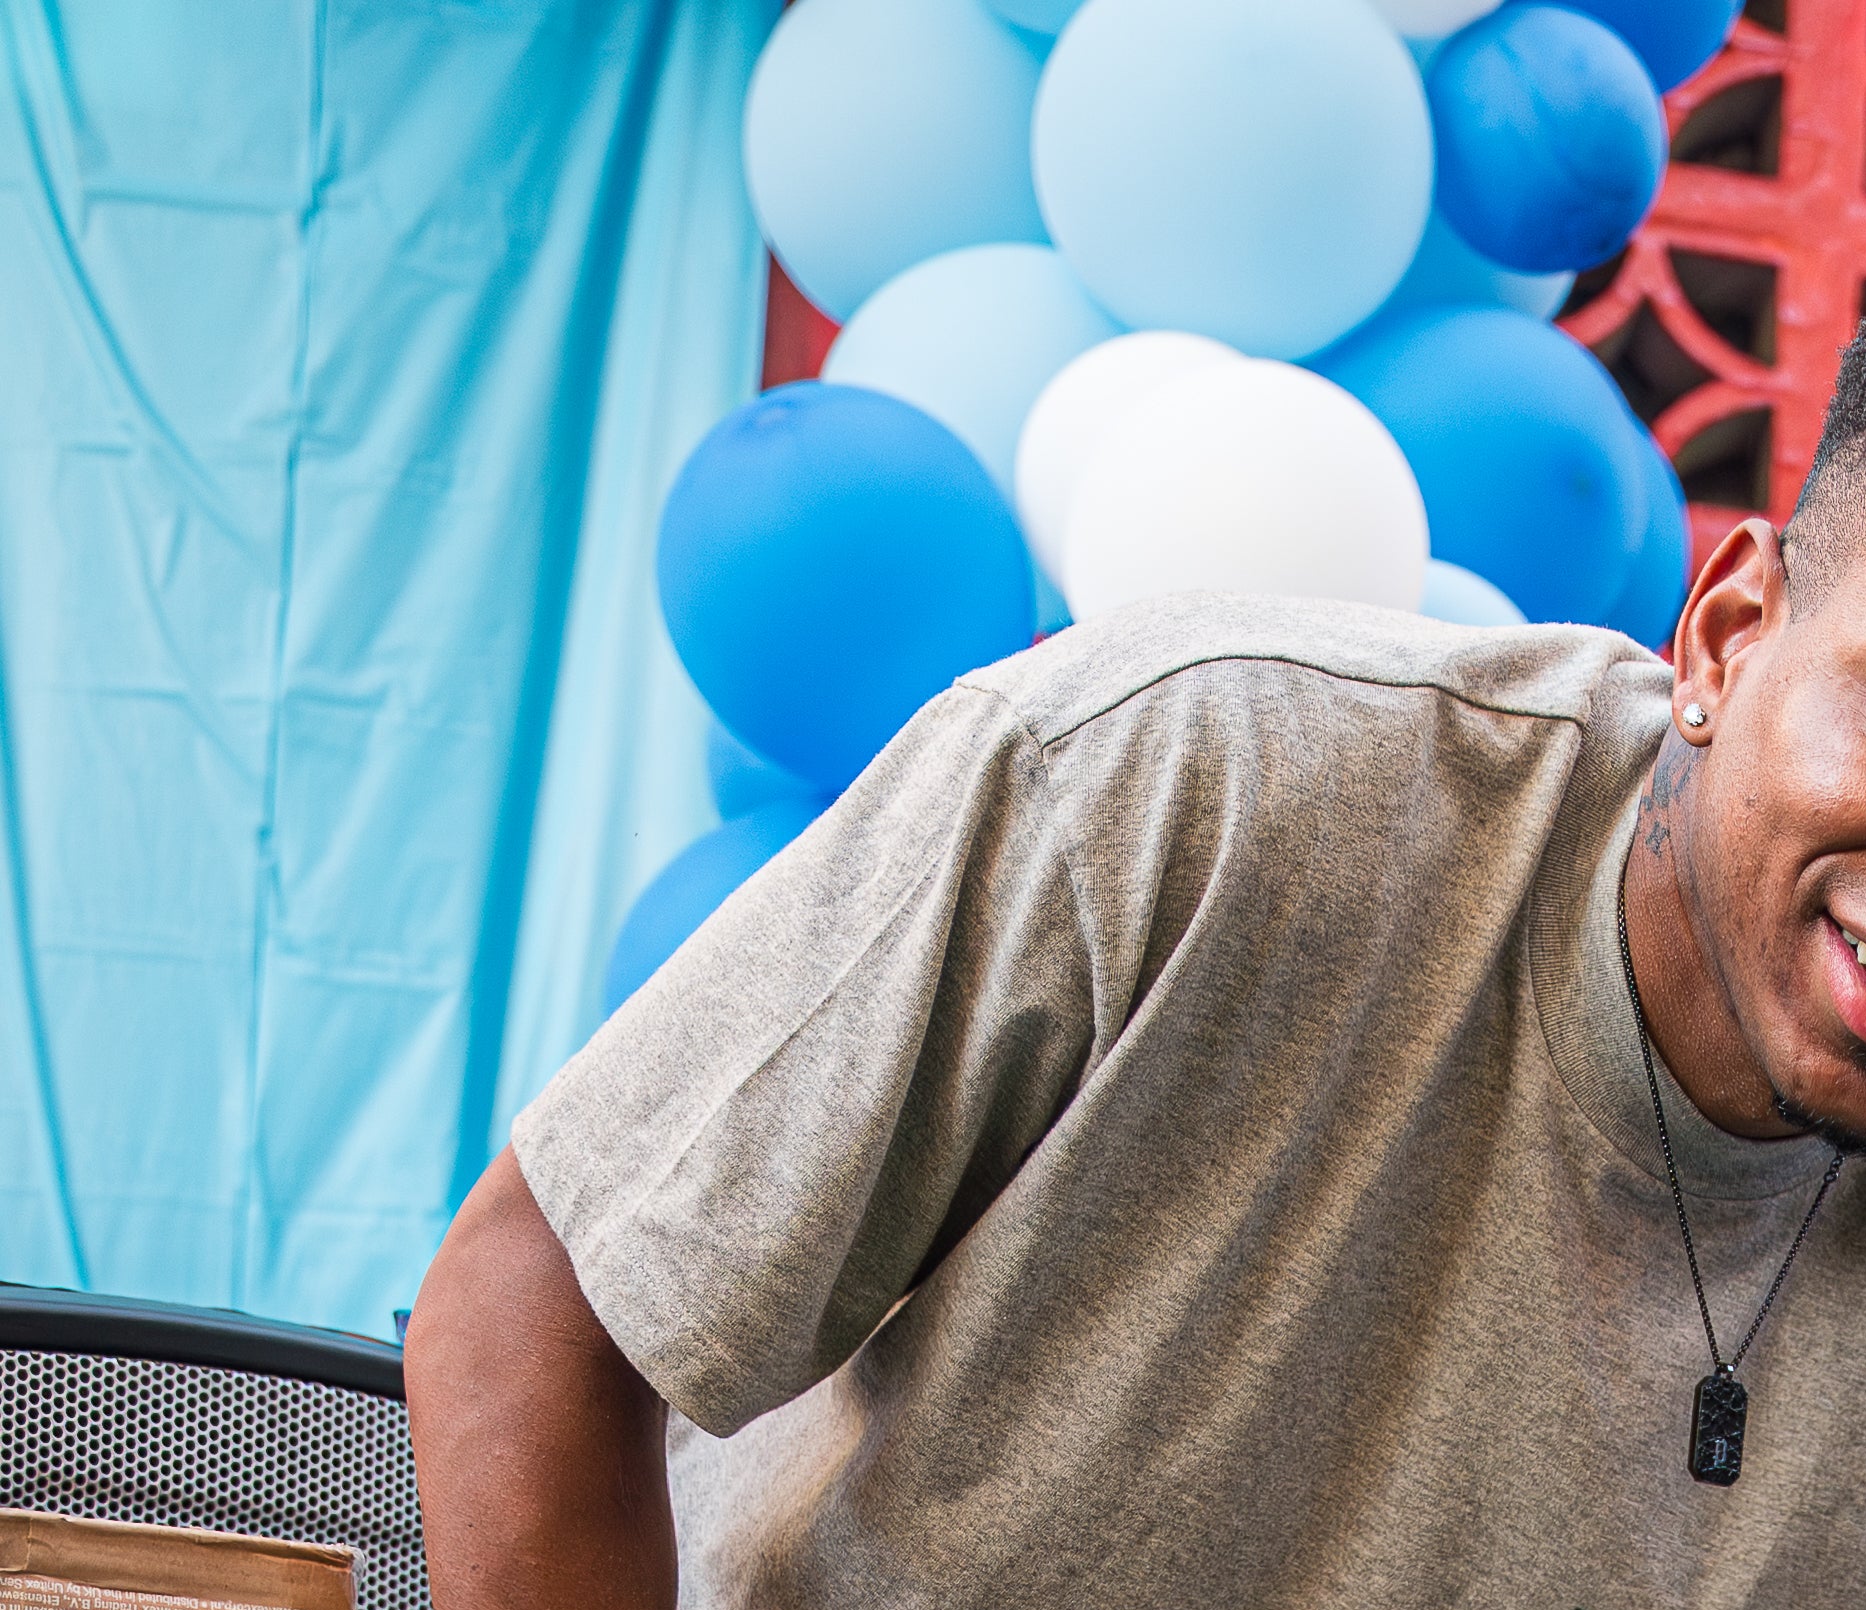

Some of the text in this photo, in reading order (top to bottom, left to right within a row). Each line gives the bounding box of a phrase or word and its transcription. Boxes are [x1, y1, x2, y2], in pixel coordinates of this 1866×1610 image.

[24, 1579, 62, 1593] Unitex
[66, 1582, 80, 1595] by
[84, 1586, 100, 1597] UK
[103, 1588, 121, 1599] the
[125, 1590, 135, 1601] in
[138, 1592, 198, 1607] Distributed
[62, 1596, 90, 1609] B.V.,
